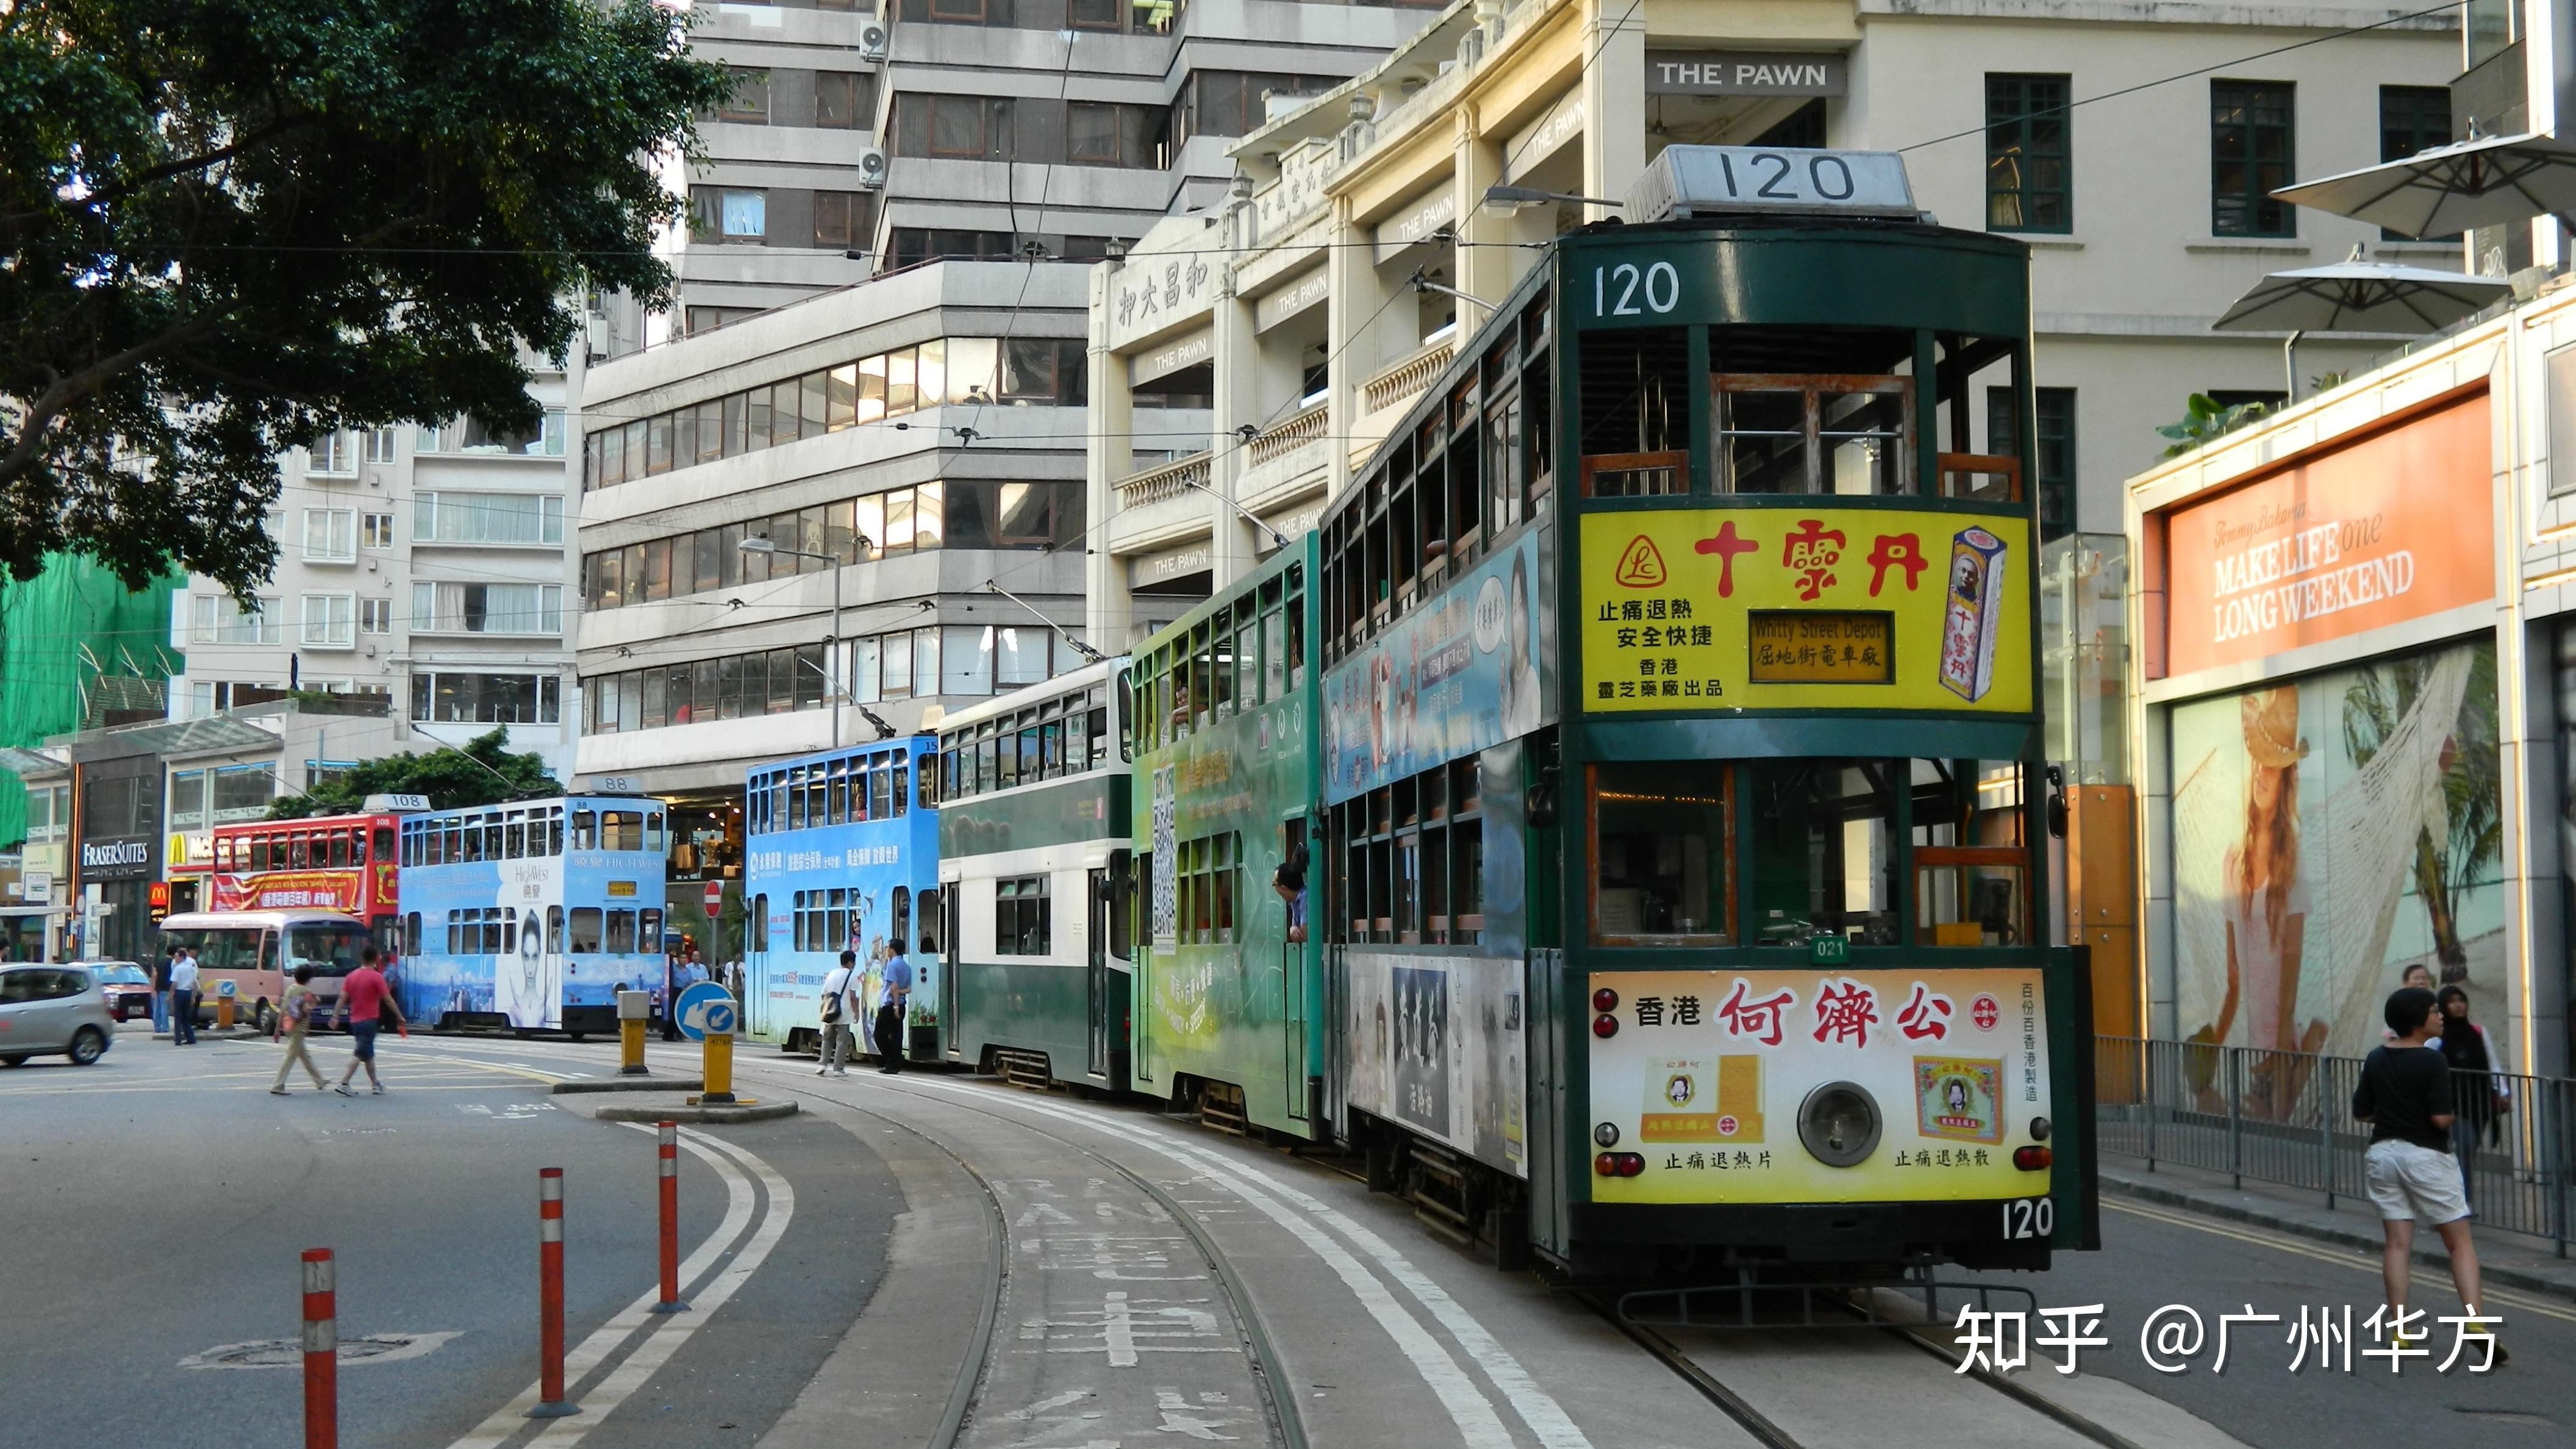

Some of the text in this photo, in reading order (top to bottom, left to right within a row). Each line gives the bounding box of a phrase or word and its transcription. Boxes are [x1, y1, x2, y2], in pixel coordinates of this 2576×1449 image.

[1657, 63, 1826, 85] THE PAWN
[1531, 127, 1552, 157] THE
[1720, 154, 1855, 201] 120
[1400, 194, 1455, 243] THE PAWN
[1279, 274, 1328, 314] THE PAWN
[1595, 261, 1680, 317] 120
[1155, 338, 1207, 371] THE PAWN
[1279, 517, 1298, 536] THE
[1154, 549, 1207, 575] THE PAWN
[1695, 520, 1928, 601] 十靈丹
[2214, 512, 2383, 599] MAKE LIFE one
[2214, 549, 2414, 643] LONG WEEKEND
[1598, 599, 1692, 621] 止痛退熱
[1618, 625, 1712, 648] 安全快捷
[1755, 618, 1881, 641] Whitty Street Depot
[1640, 658, 1678, 675] 香港
[1757, 644, 1881, 668] 屈地街電車廠
[1598, 679, 1722, 699] 靈芝藥廠出品
[606, 778, 627, 790] 88
[393, 795, 420, 807] 108
[1817, 941, 1844, 957] 021
[1636, 982, 1953, 1047] 香港 何濟公
[2022, 983, 2038, 1102] 百份百香港製造
[1664, 1151, 1771, 1170] 止痛退熱片
[1895, 1148, 1989, 1167] 止痛退熱散
[2003, 1198, 2053, 1239] 120
